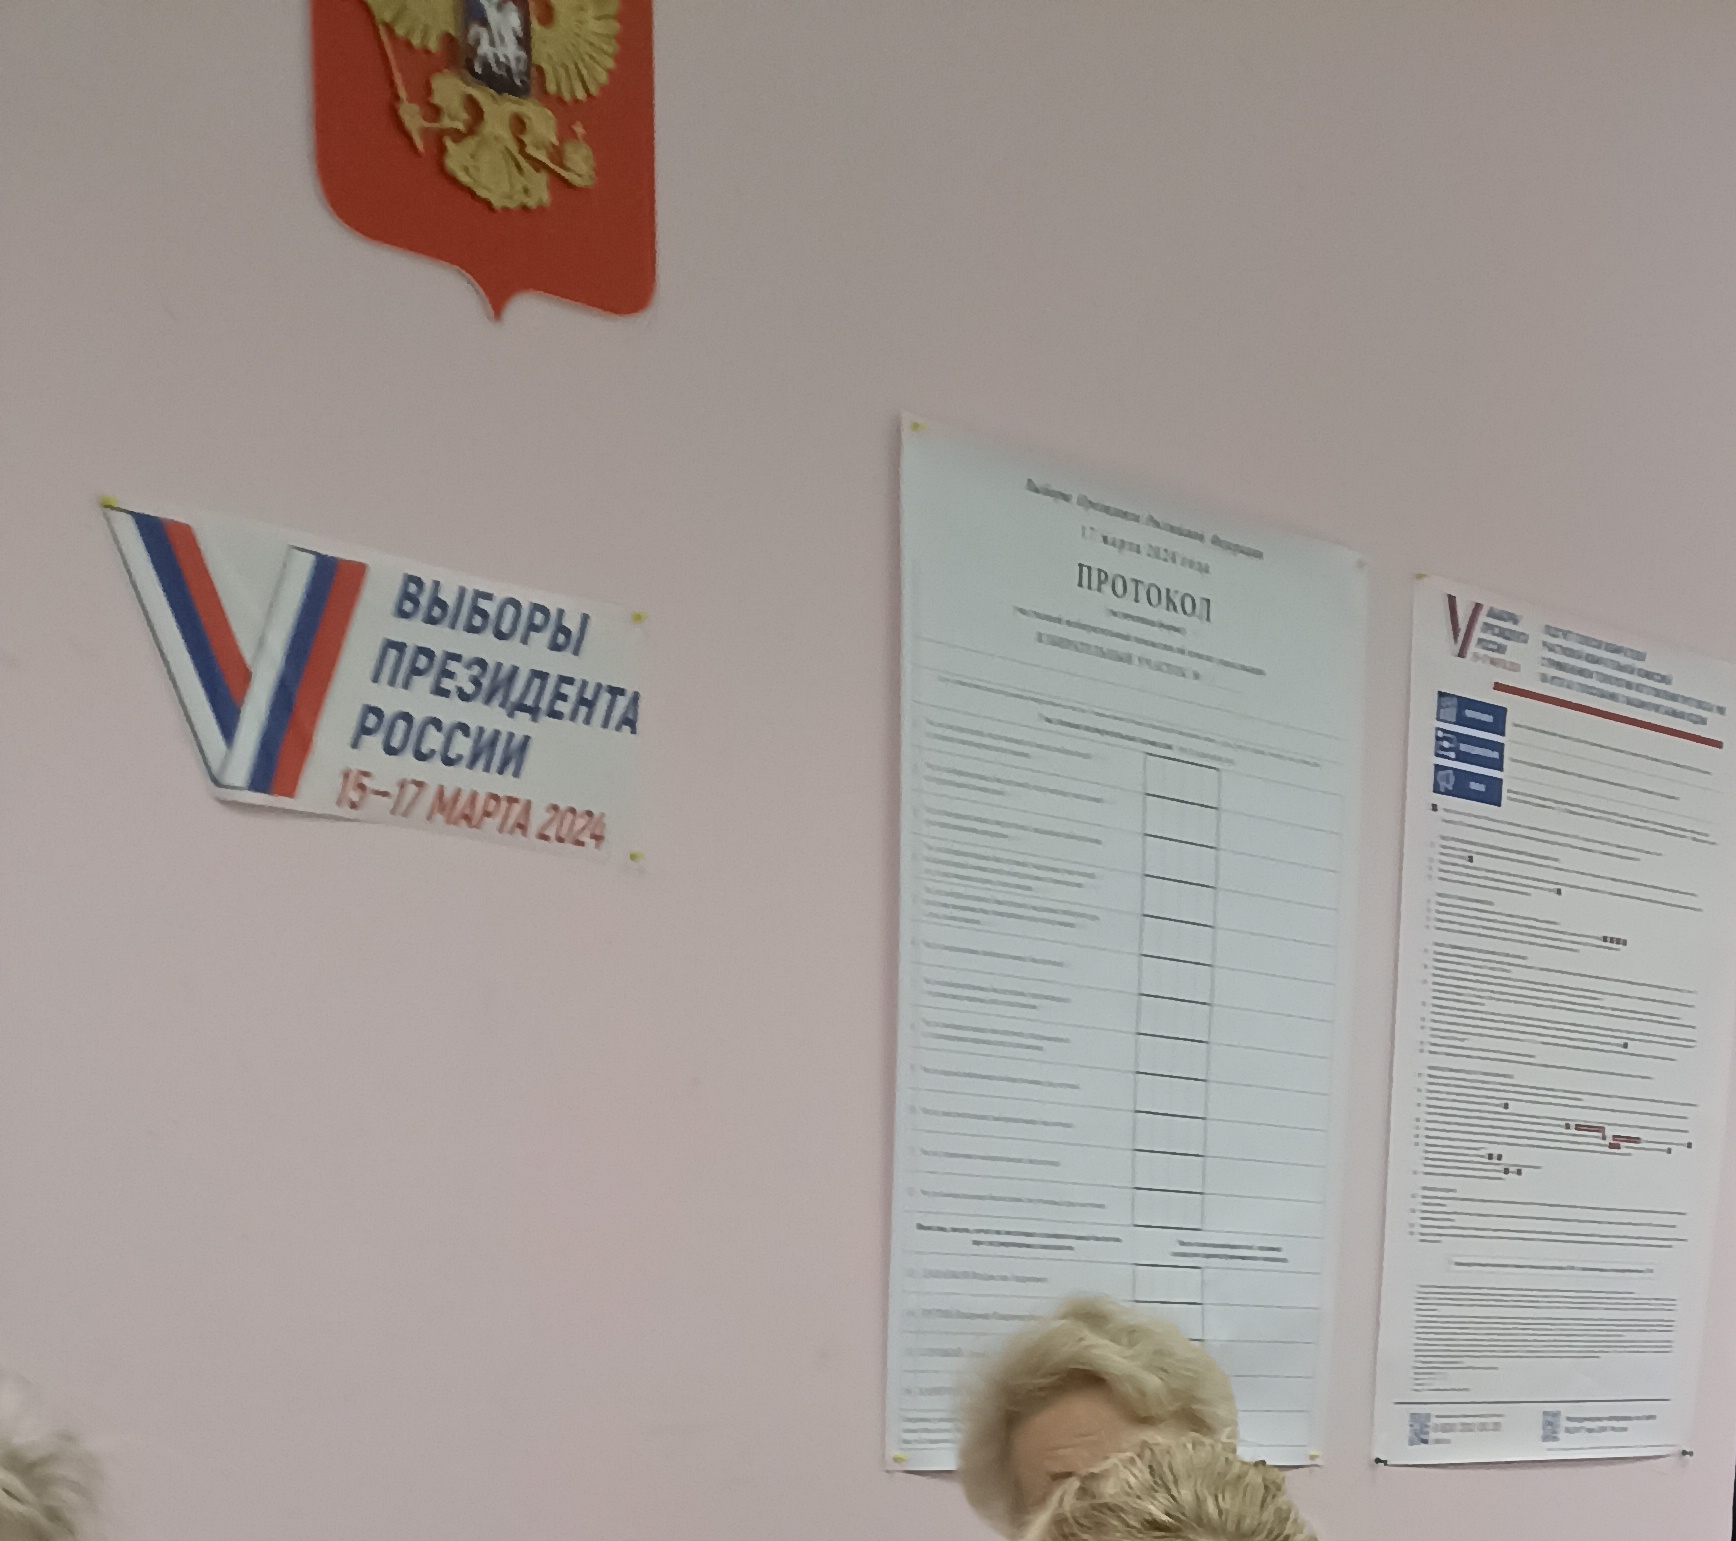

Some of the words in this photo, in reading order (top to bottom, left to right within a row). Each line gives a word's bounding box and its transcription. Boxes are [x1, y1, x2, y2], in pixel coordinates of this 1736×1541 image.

[393, 573, 590, 656] ВЫБОРЫ
[1076, 563, 1213, 623] ПРОТОКОЛ
[371, 637, 641, 734] ПРЕЗИДЕНТА
[350, 704, 531, 778] РОССИИ
[426, 784, 532, 838] МАРТА
[535, 802, 606, 849] 2024
